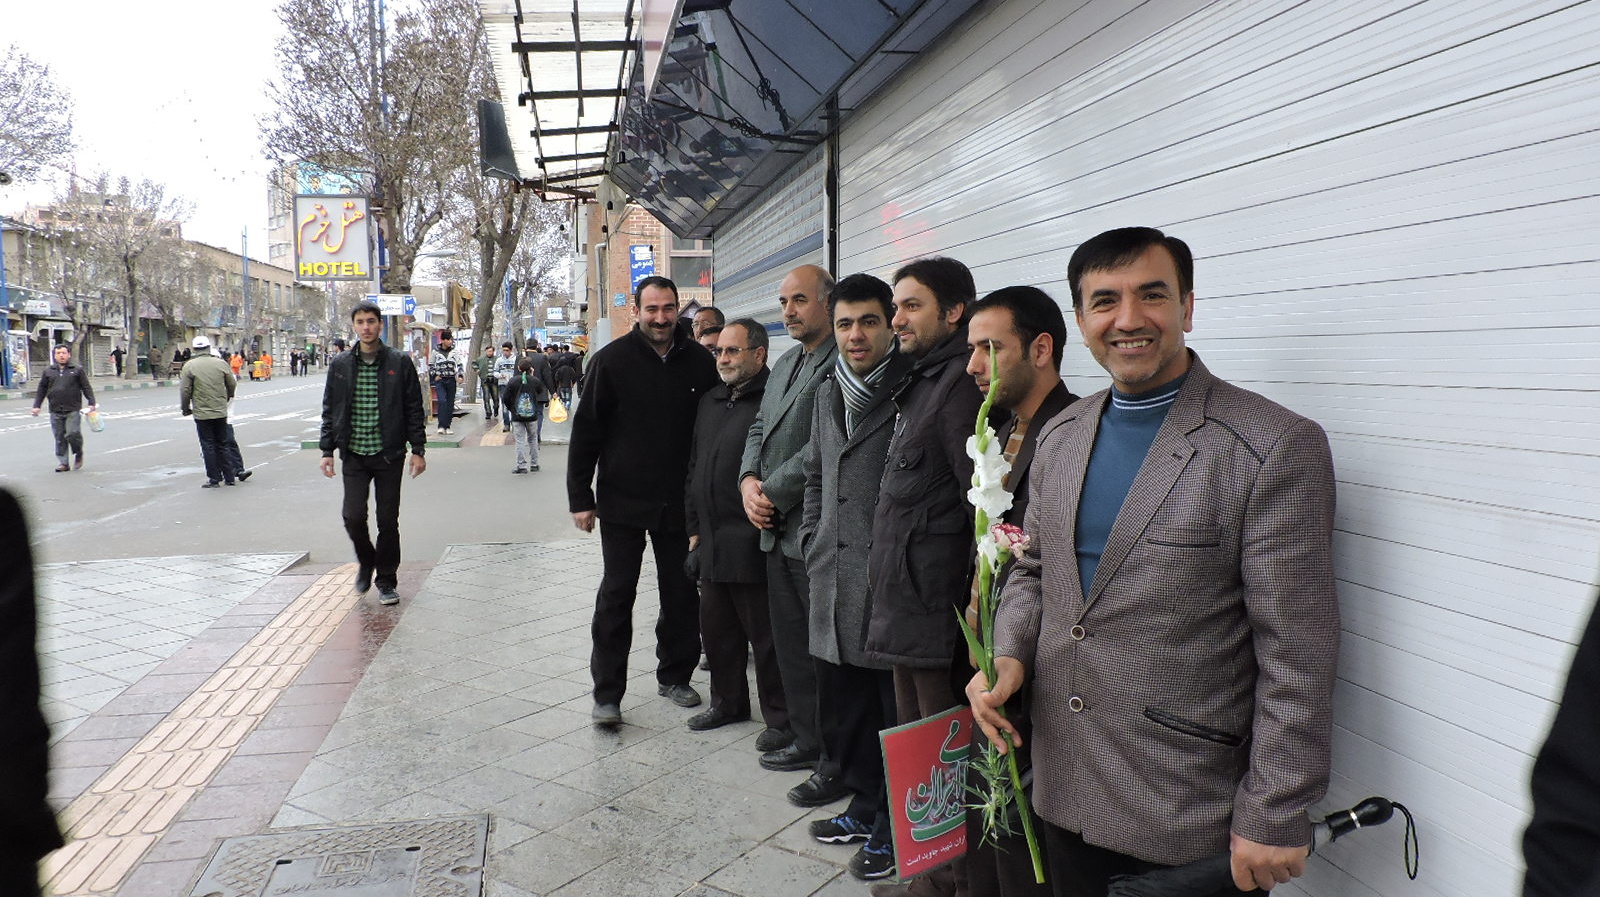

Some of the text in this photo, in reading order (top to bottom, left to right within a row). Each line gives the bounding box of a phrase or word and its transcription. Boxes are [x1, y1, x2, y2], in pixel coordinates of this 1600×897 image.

[323, 201, 365, 254] هتل
[299, 262, 367, 276] HOTEL
[906, 854, 921, 866] است
